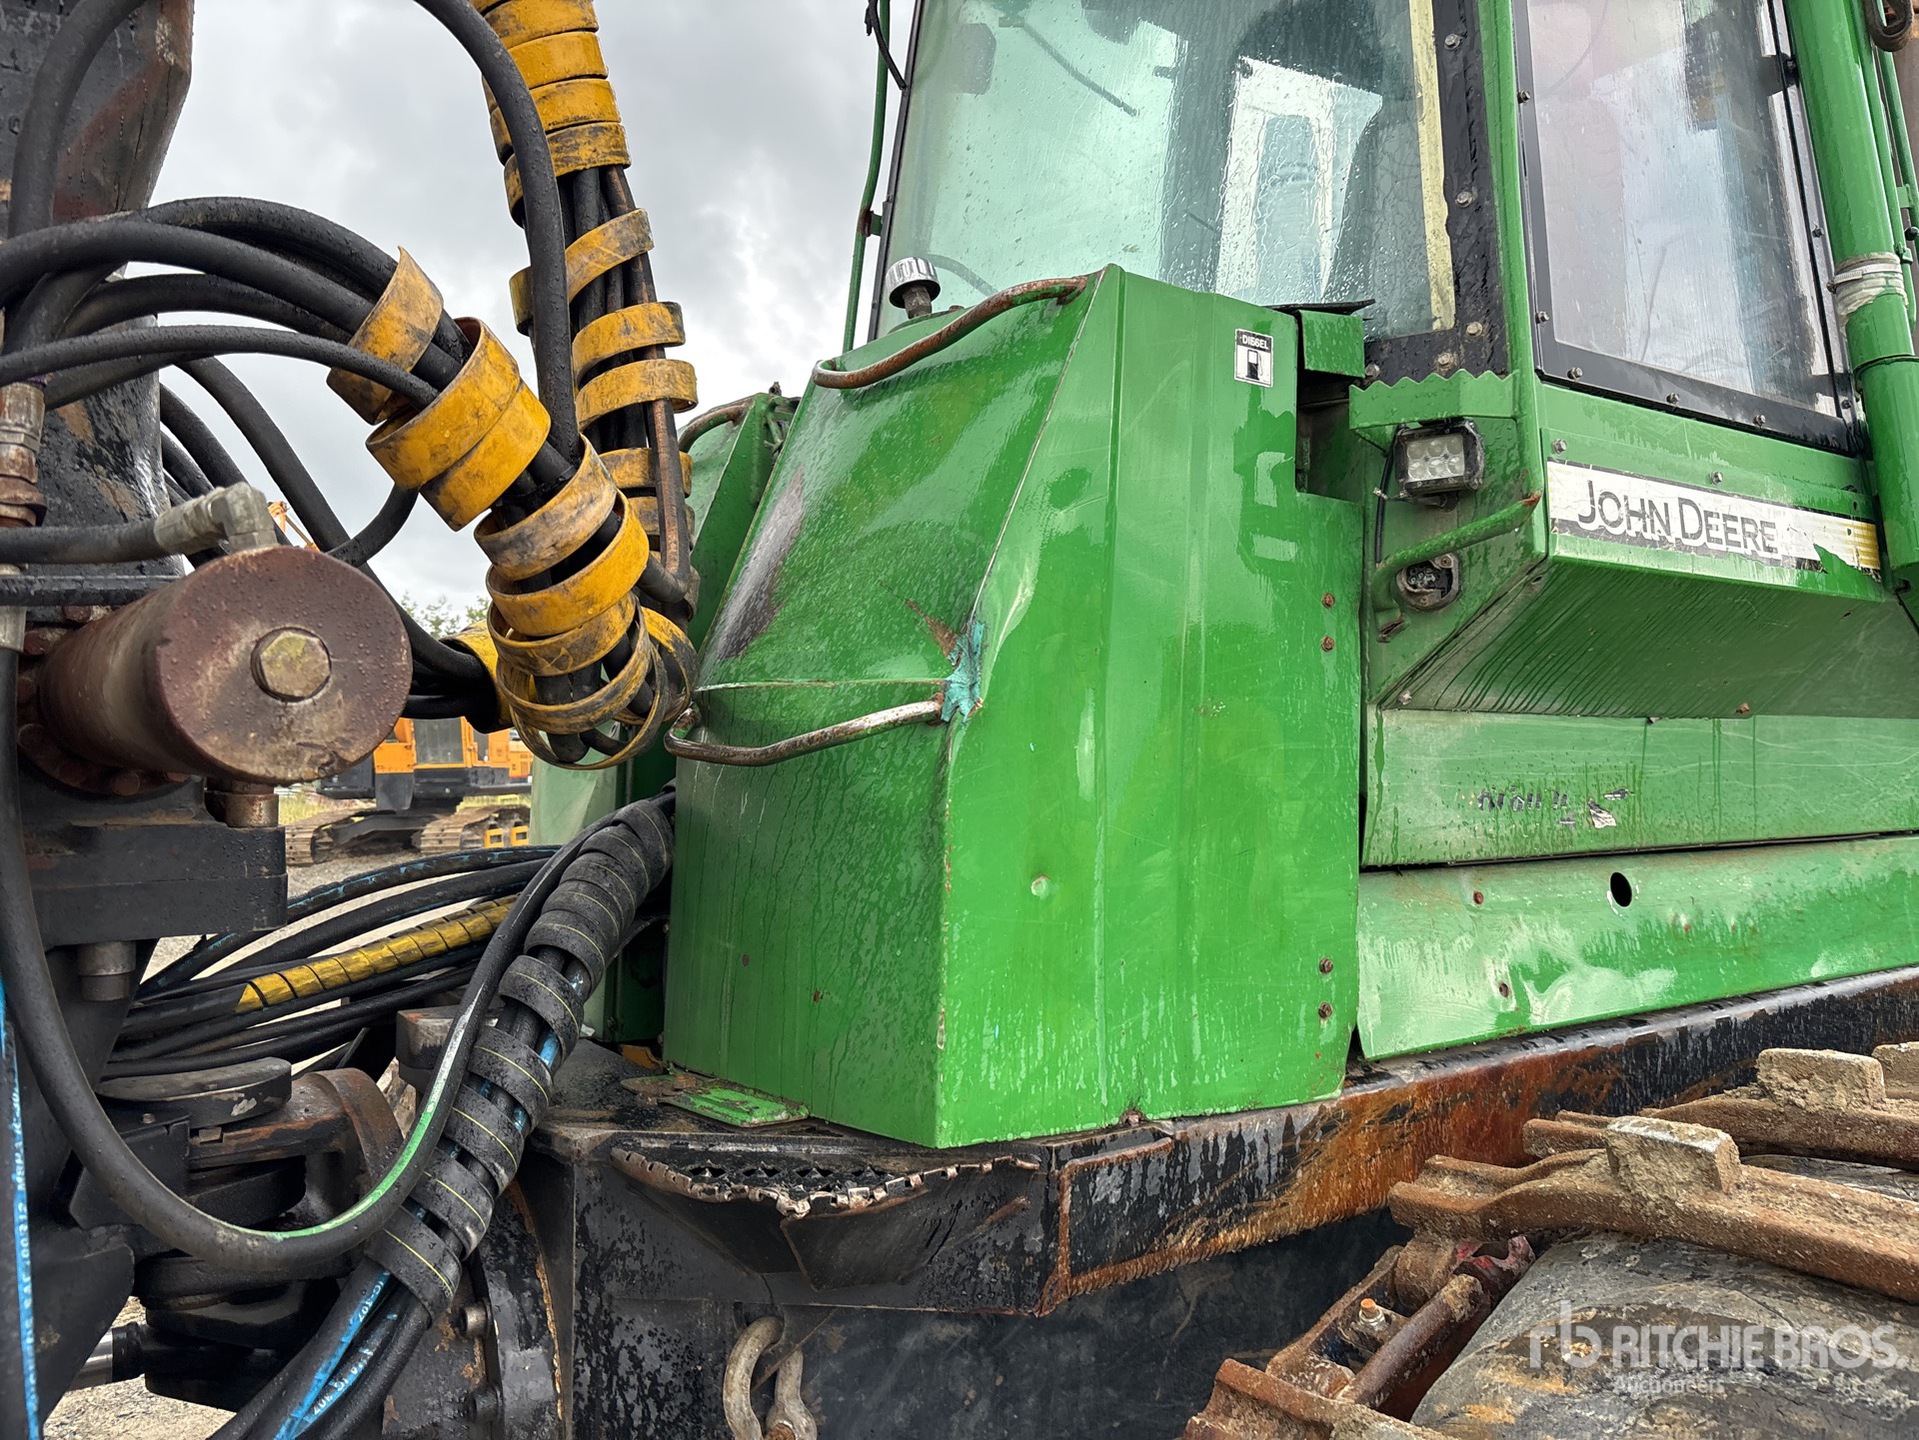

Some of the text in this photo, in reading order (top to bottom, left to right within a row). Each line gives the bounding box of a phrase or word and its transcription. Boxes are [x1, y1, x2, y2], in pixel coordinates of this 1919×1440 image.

[1242, 334, 1270, 350] DIESEL
[1578, 480, 1778, 553] JOHN DEERE
